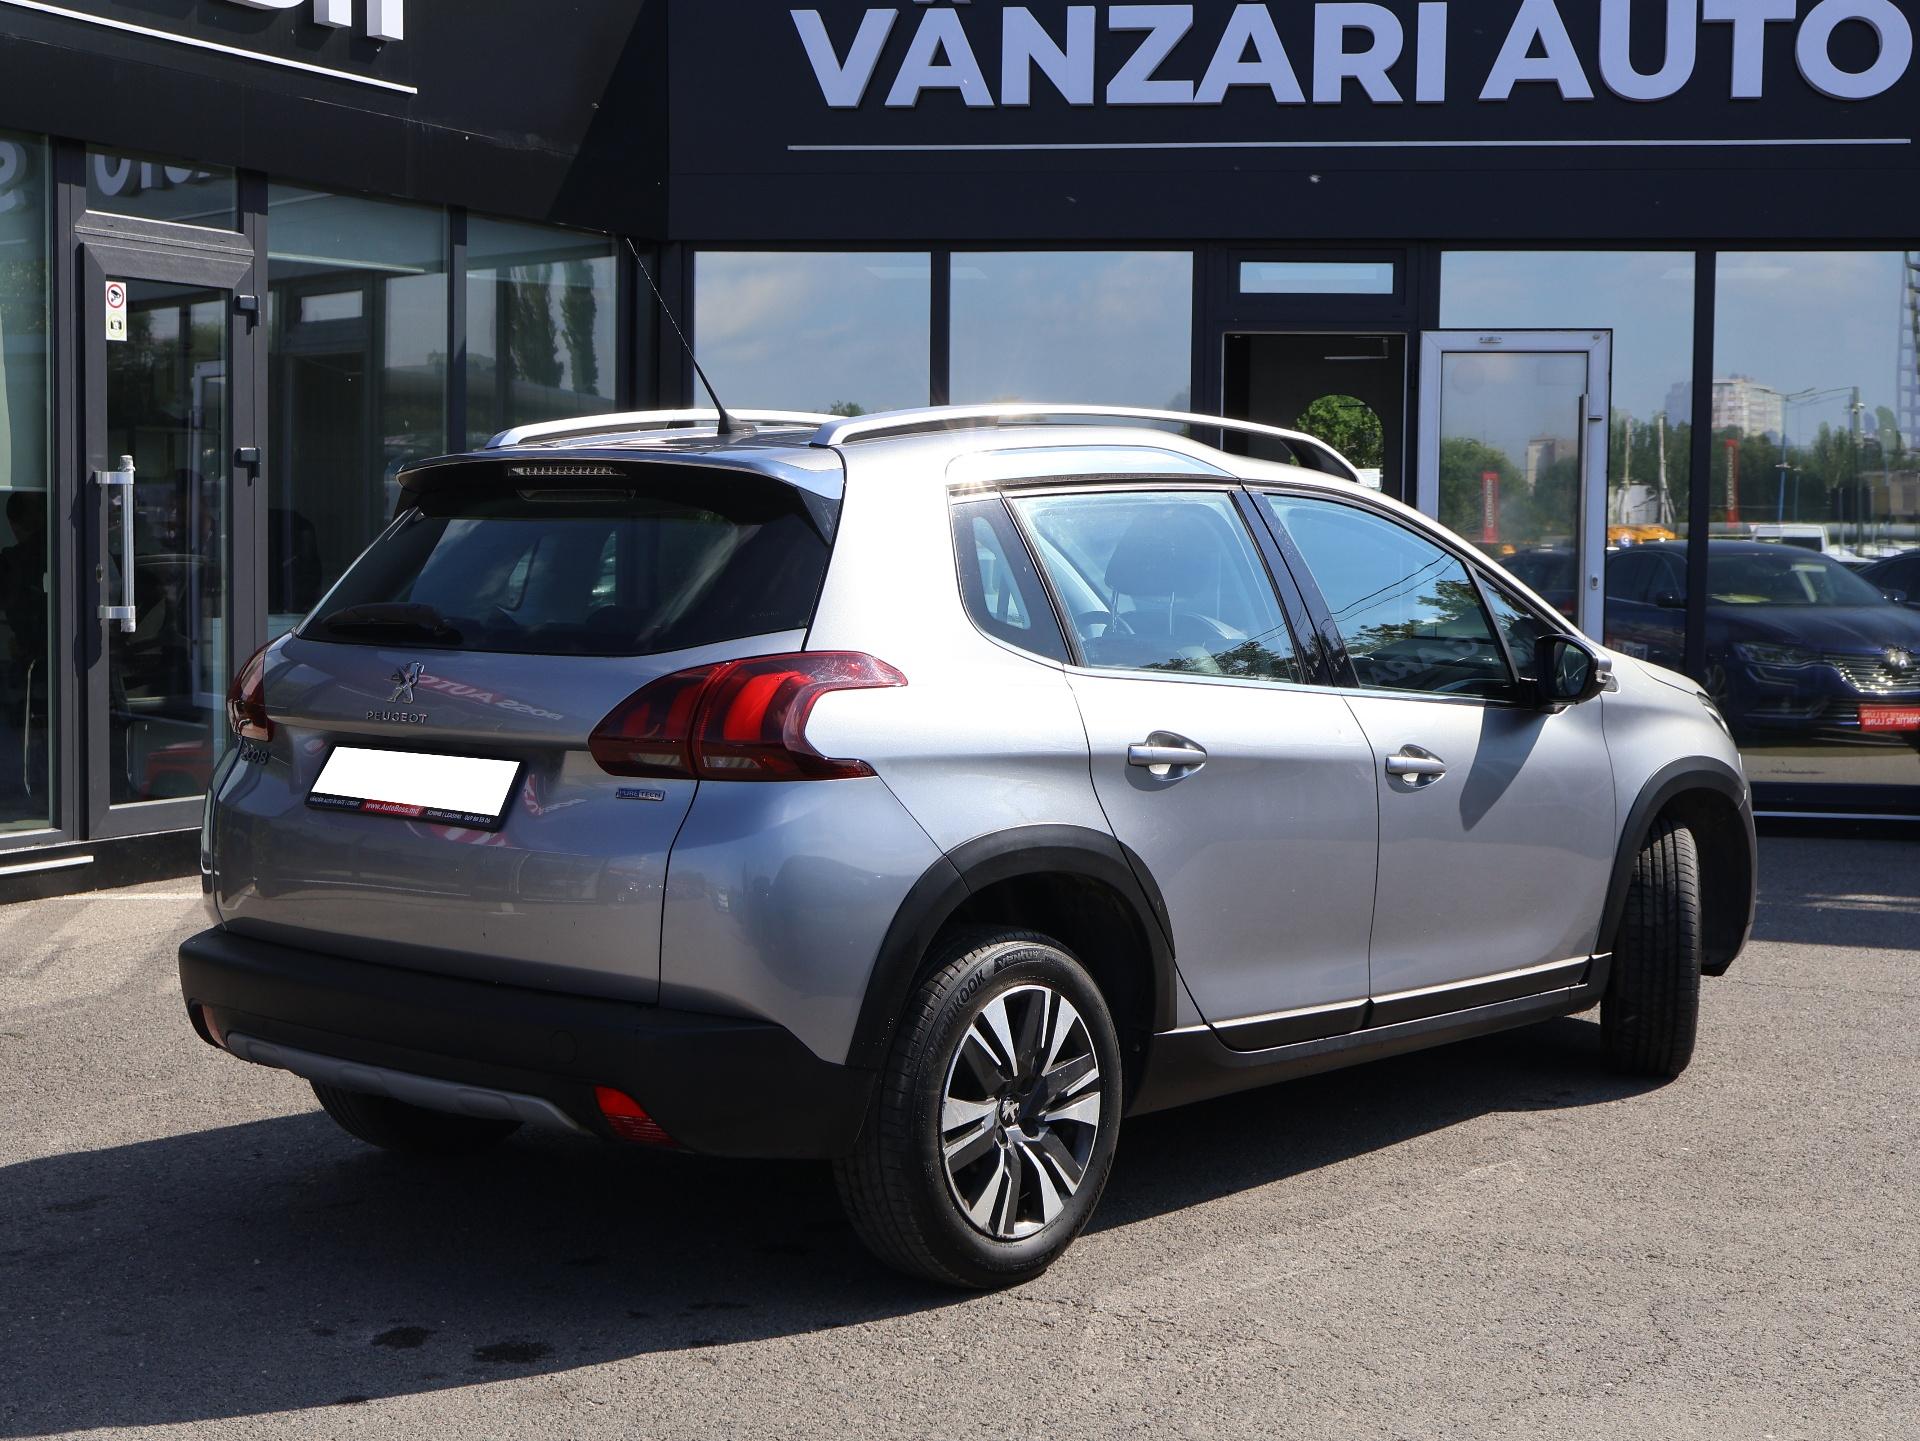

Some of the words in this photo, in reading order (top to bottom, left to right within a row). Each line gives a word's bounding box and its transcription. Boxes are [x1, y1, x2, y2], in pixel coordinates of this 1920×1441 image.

[1478, 0, 1913, 102] AUTO
[366, 710, 427, 724] PEUGEOT
[365, 802, 420, 815] www.AutoBoss.md
